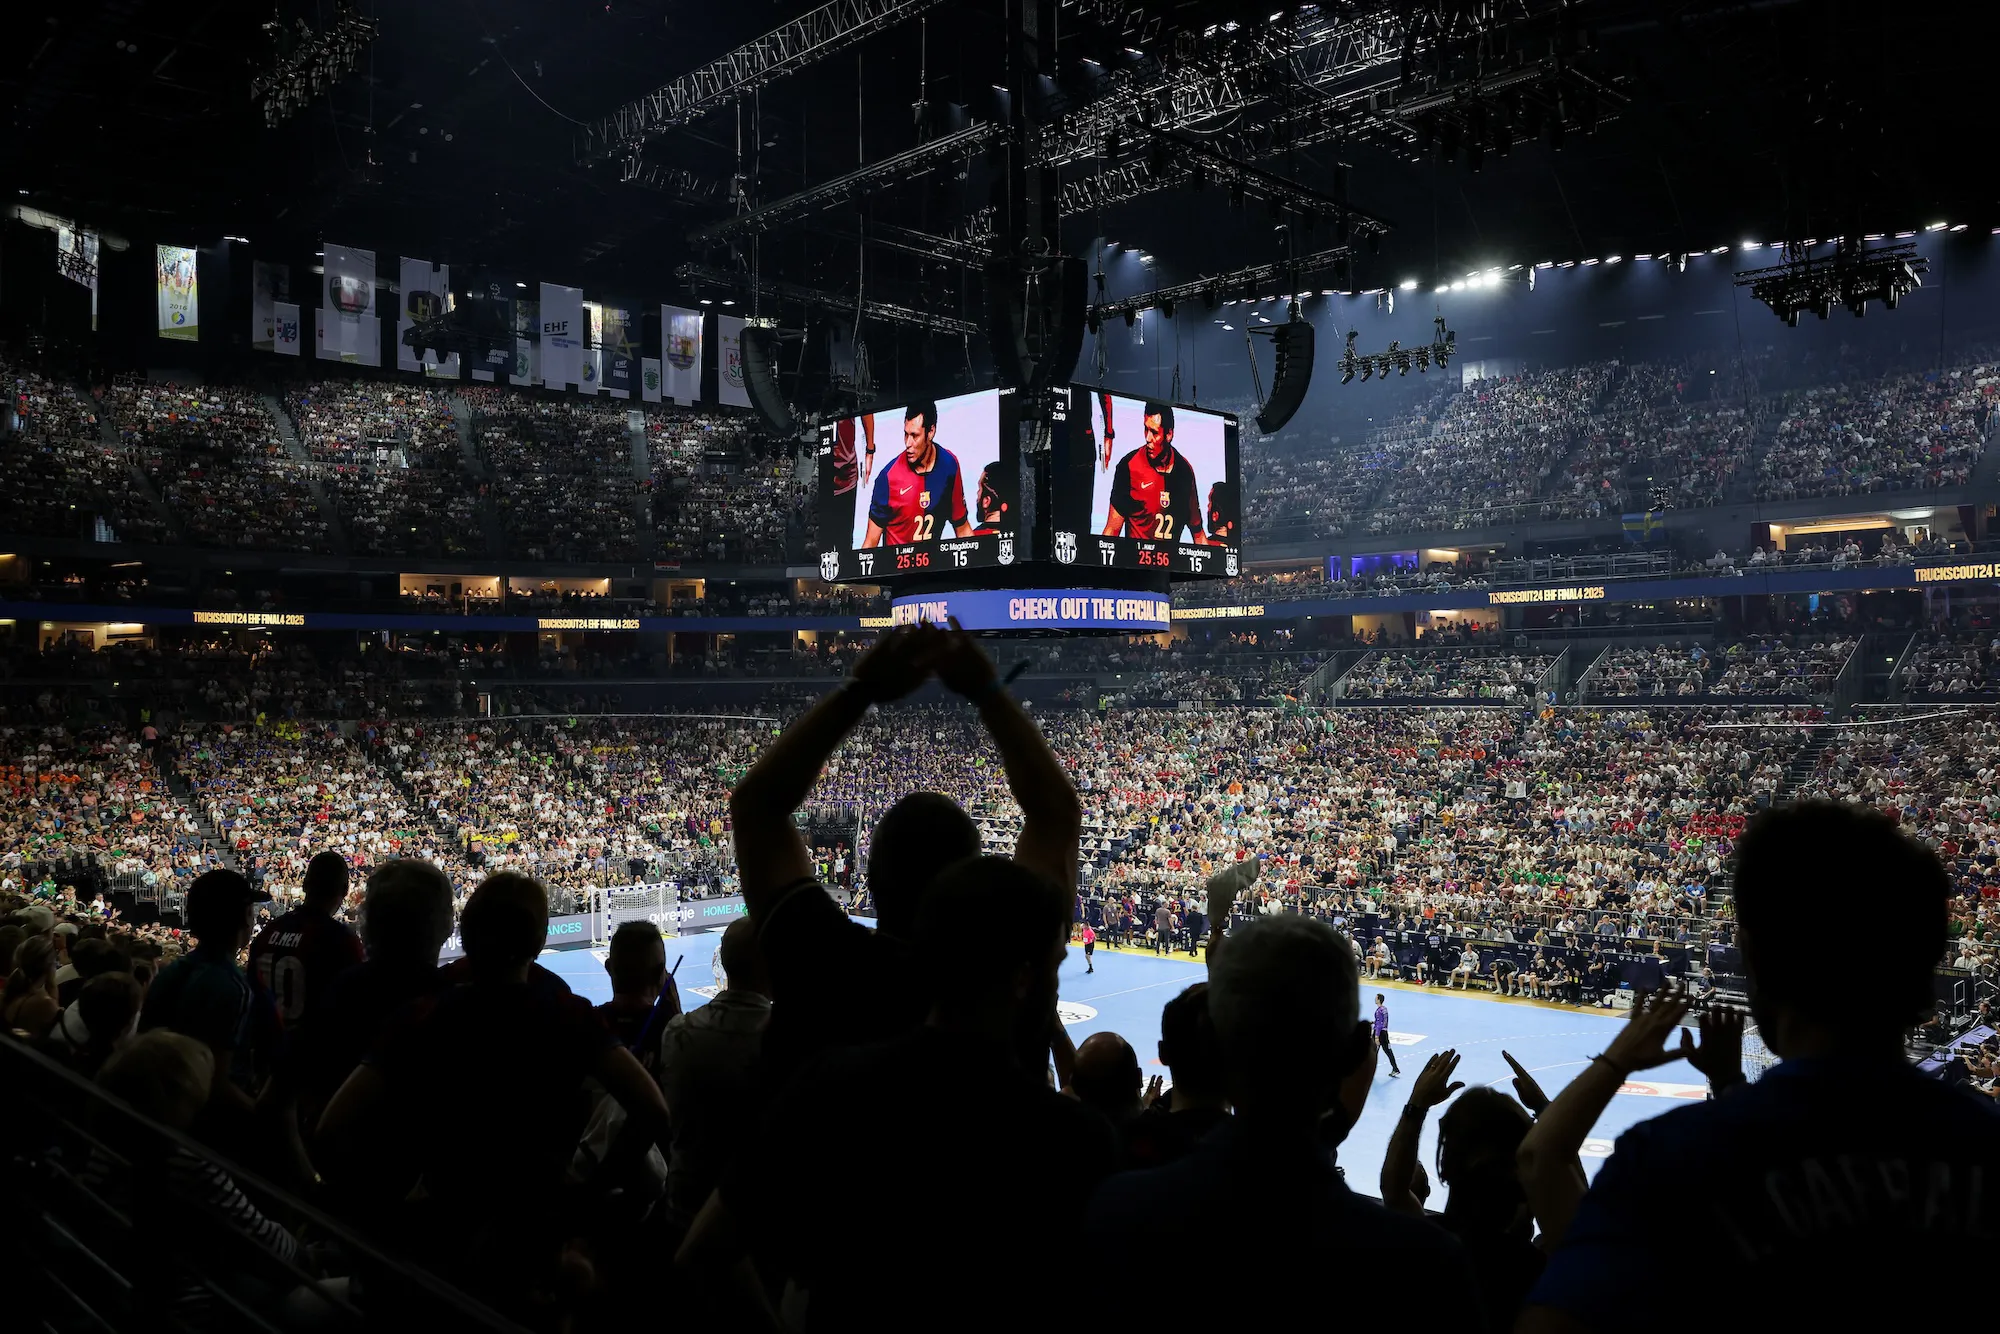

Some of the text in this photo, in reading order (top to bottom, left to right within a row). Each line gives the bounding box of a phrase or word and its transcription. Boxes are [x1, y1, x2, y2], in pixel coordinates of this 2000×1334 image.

[544, 321, 568, 332] EHF
[1056, 401, 1064, 410] 22
[1052, 411, 1066, 421] 2:00
[823, 437, 830, 445] 22
[820, 446, 831, 455] 2:00
[912, 514, 934, 541] 22
[1154, 513, 1174, 539] 22
[940, 541, 979, 551] SC Magdeburg
[1099, 540, 1115, 550] Barça
[859, 552, 873, 562] Barça
[897, 552, 929, 569] 25:56
[953, 551, 967, 567] 15
[1101, 549, 1115, 565] 17
[1139, 551, 1169, 566] 25:56
[1178, 547, 1211, 559] SC Magdeburg
[860, 560, 874, 575] 17
[1190, 557, 1202, 572] 15
[1914, 564, 1993, 582] TRUCKSCOUT24
[1488, 587, 1604, 604] TRUCKSCOUT24 EHF FINAL4 2025
[920, 601, 948, 624] ZONE
[1010, 598, 1058, 620] CHECK
[1060, 598, 1088, 620] OUT
[1091, 598, 1115, 620] THE
[1116, 599, 1155, 622] OFFICIAL
[1171, 605, 1264, 620] TRUCKSCOUT24 EHF FINAL4 2025
[193, 612, 304, 625] TRUCKSCOUT24 EHF FINAL4 2025
[538, 619, 639, 630] TRUCKSCOUT24 EHF FINAL4 2025
[650, 906, 695, 923] gorenje
[703, 907, 732, 916] HOME
[547, 922, 582, 936] ANCES
